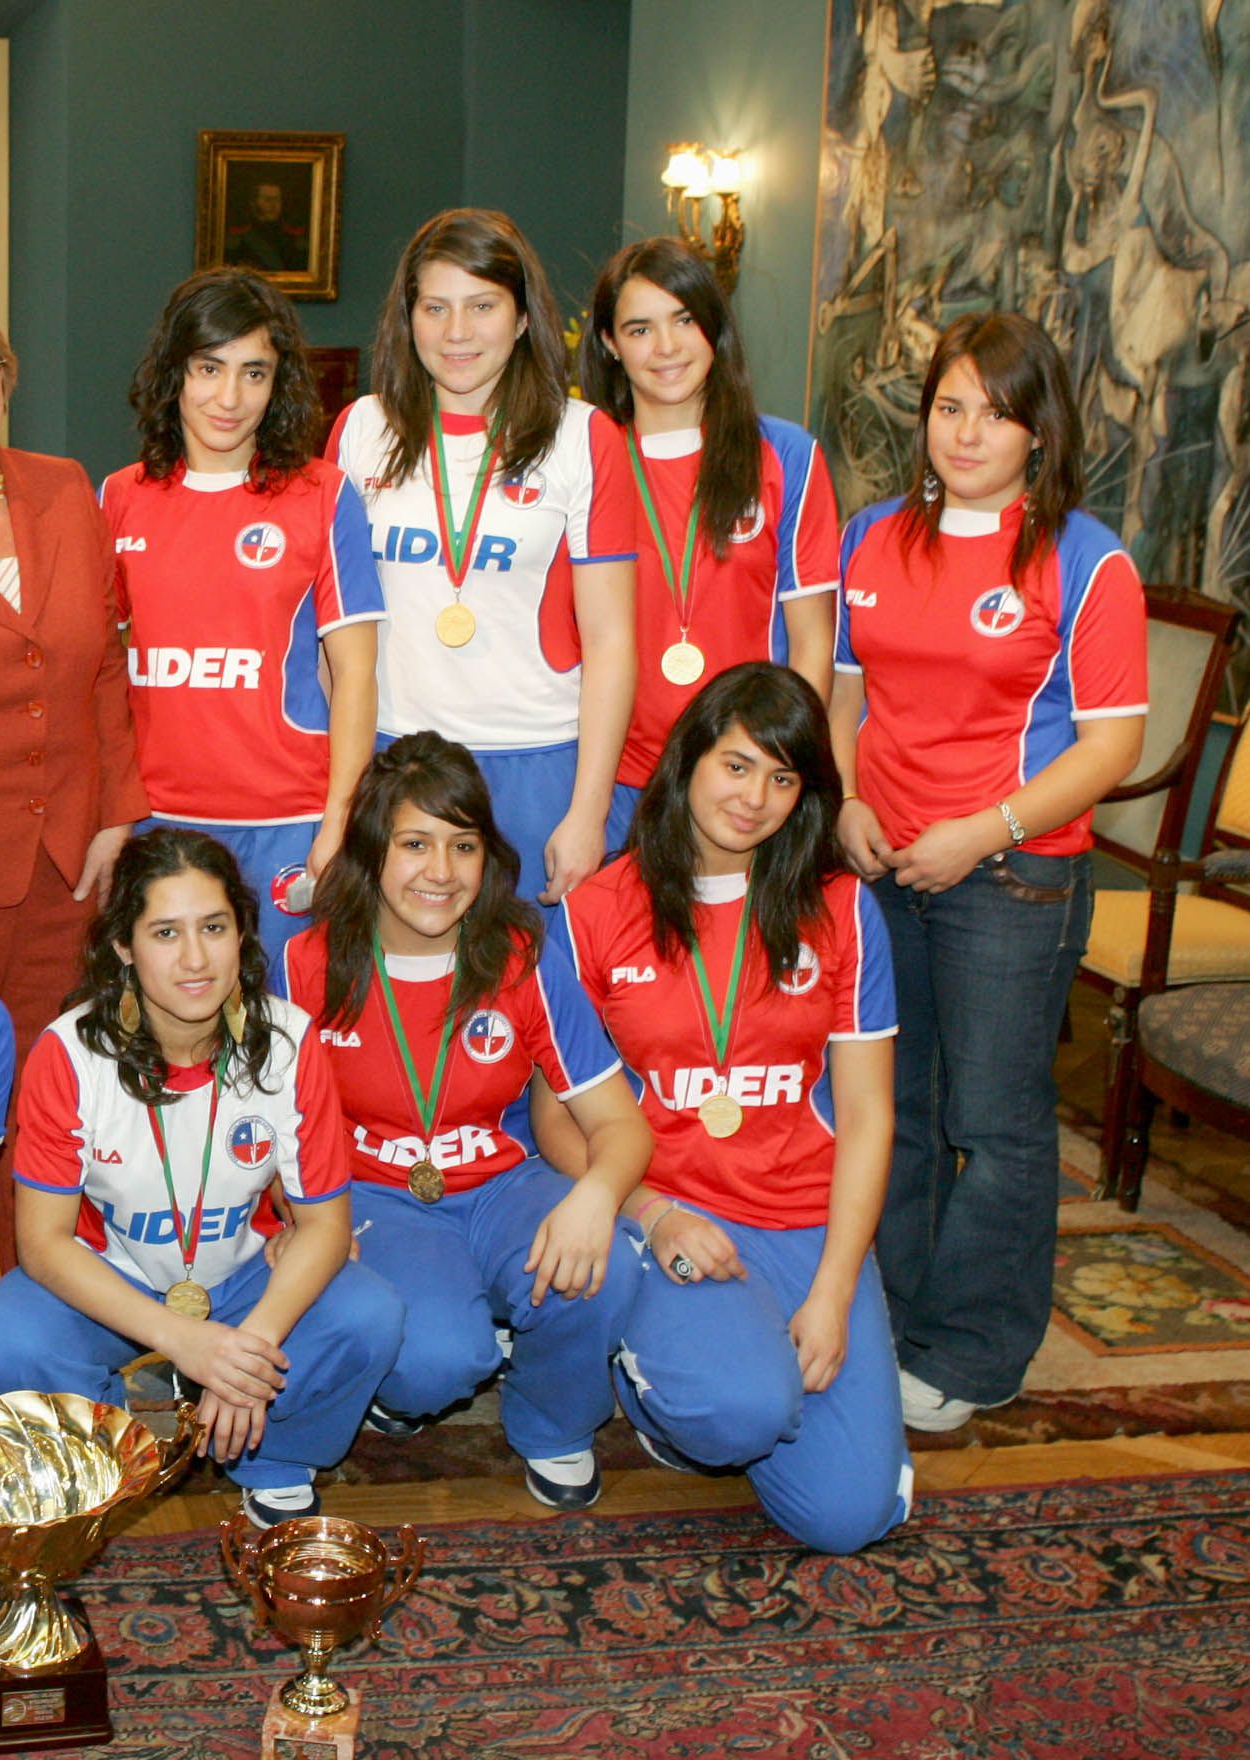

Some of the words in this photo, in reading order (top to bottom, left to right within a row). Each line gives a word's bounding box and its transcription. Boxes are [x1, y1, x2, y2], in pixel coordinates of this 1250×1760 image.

[846, 589, 877, 607] FILA
[128, 647, 263, 689] LIDER
[612, 966, 656, 984] FILA
[320, 1029, 361, 1047] FILA
[649, 1064, 803, 1111] LIDER
[93, 1148, 122, 1164] ILA
[353, 1125, 497, 1170] LIDER
